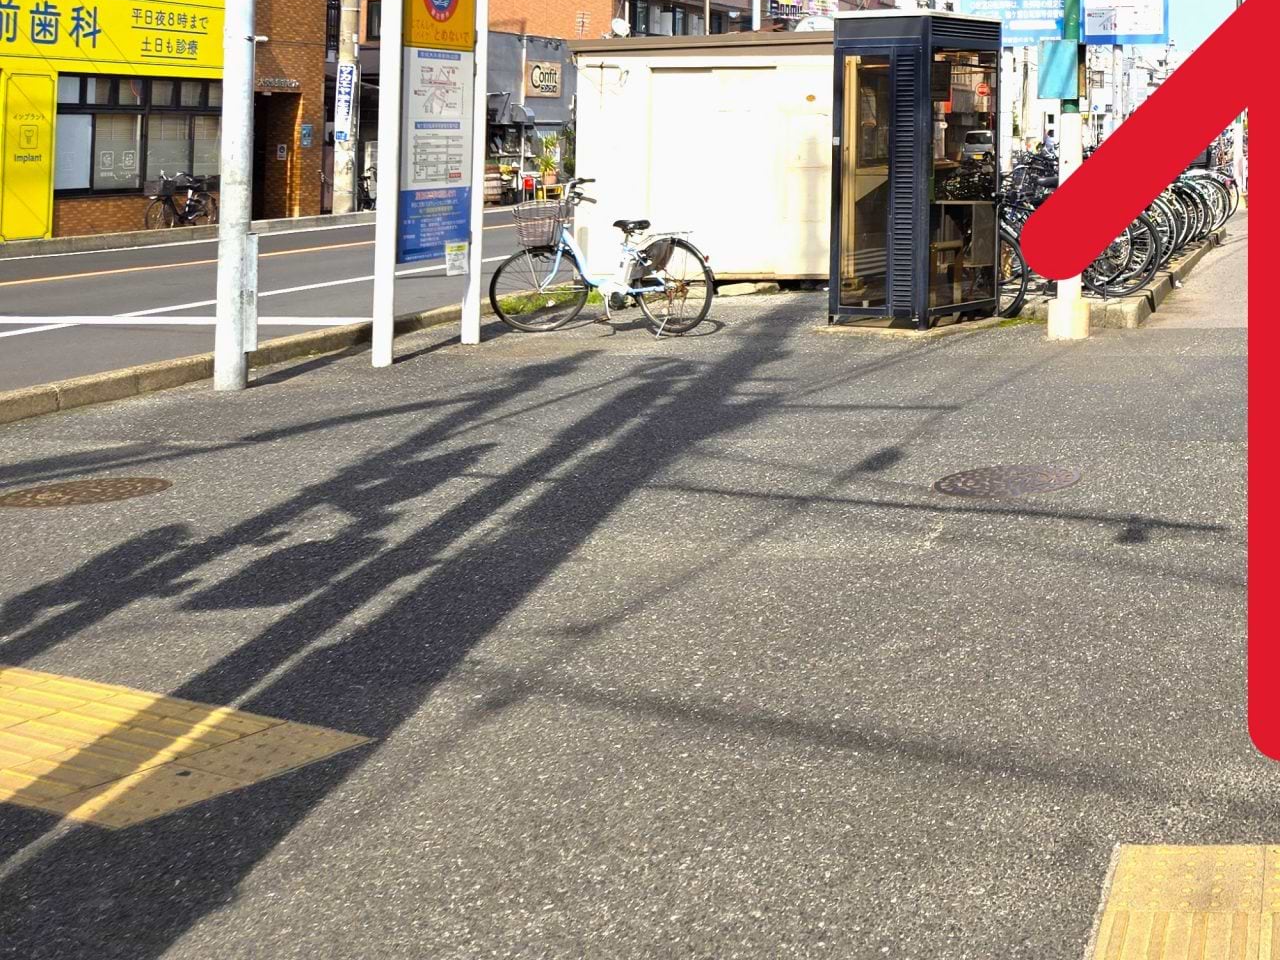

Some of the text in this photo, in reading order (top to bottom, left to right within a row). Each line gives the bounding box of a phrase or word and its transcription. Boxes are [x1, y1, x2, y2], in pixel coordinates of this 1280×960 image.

[131, 7, 209, 30] 平日夜8時まで
[141, 36, 199, 55] 土日も診療
[531, 65, 557, 88] Confit
[14, 152, 42, 164] Implant
